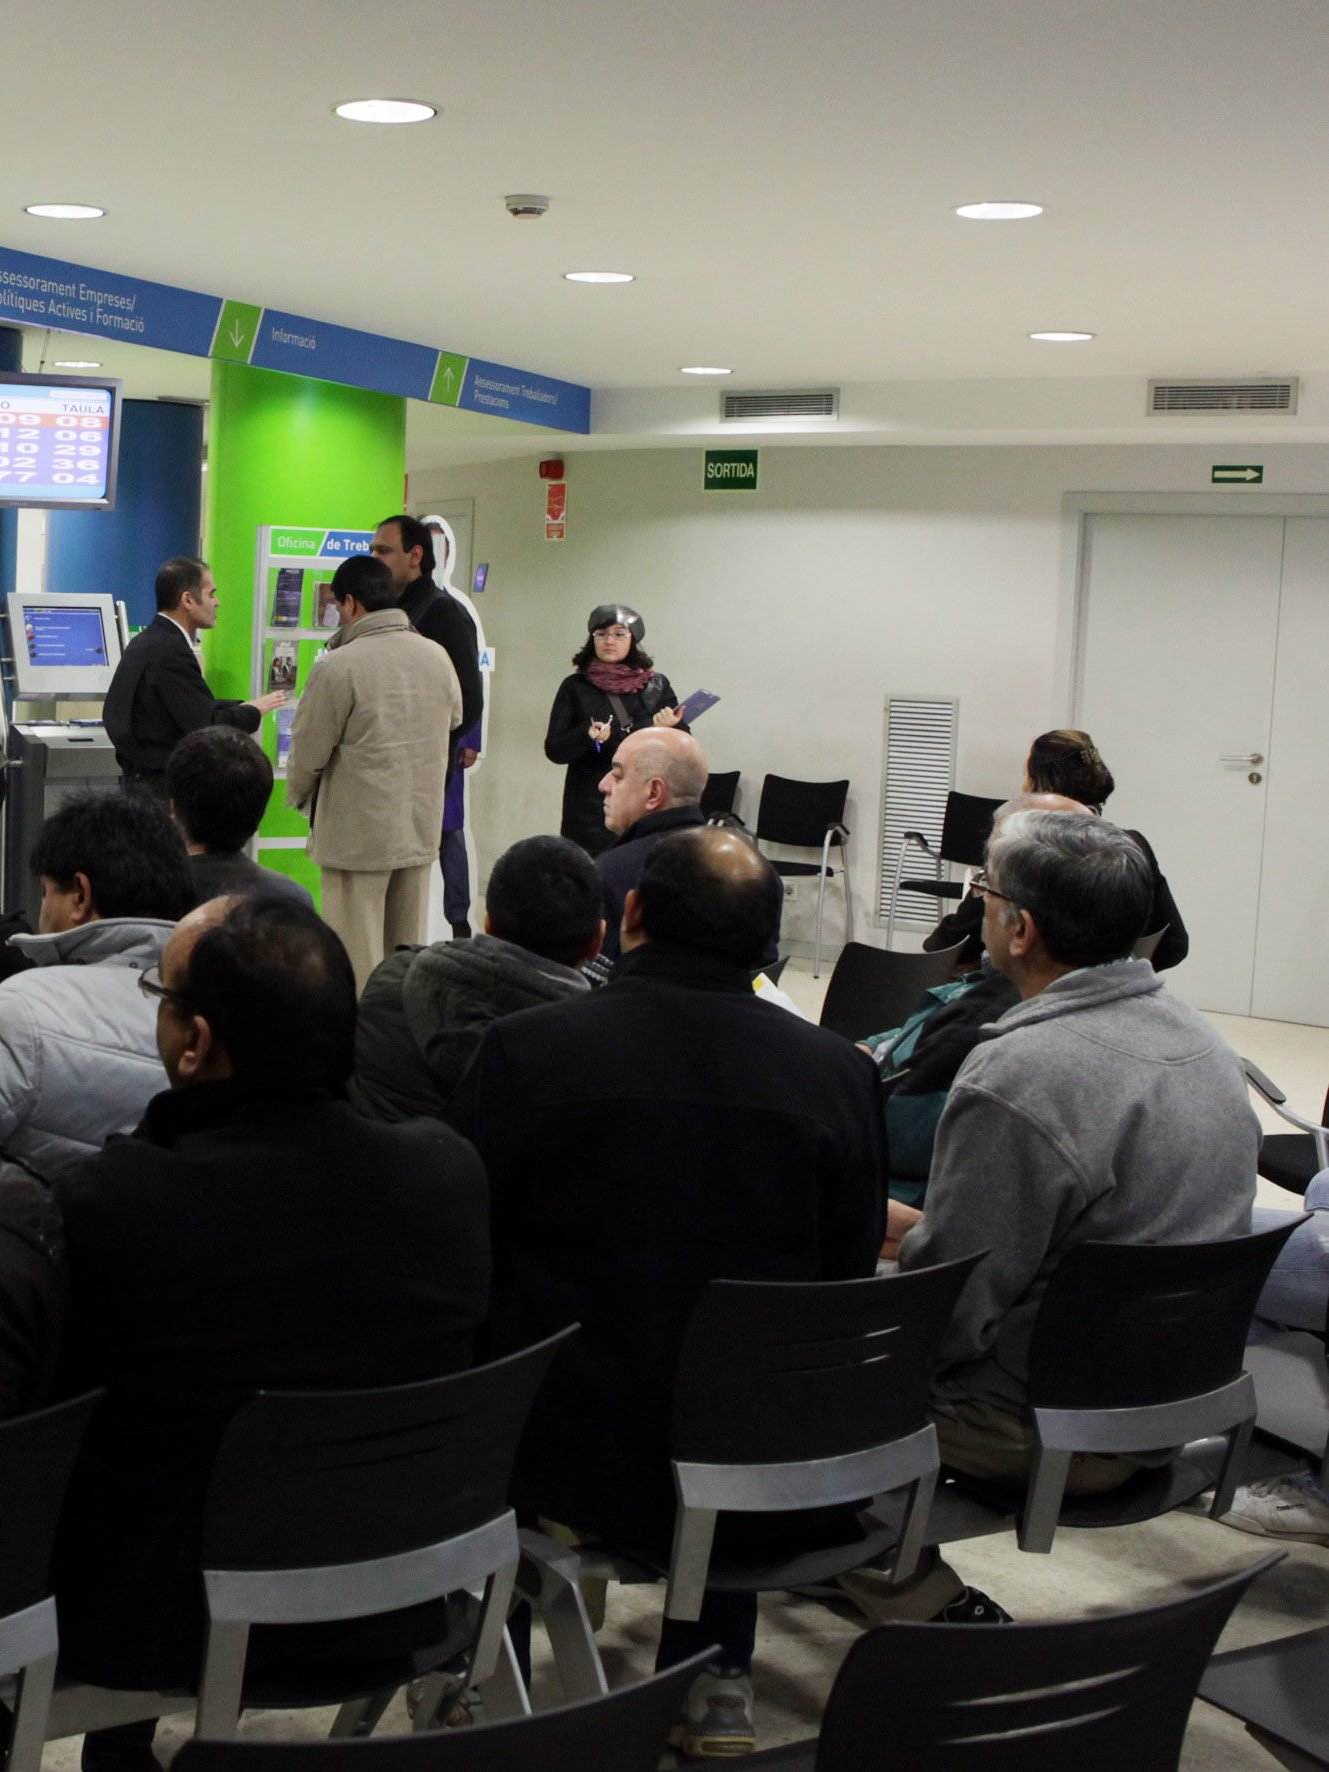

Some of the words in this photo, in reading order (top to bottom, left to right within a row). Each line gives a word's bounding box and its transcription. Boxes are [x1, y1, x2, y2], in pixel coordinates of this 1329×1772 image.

[79, 283, 137, 312] Empreses/
[48, 299, 88, 322] Actives
[96, 308, 145, 333] Formació
[271, 327, 317, 350] Informació
[62, 404, 105, 414] TAULA
[55, 417, 102, 428] 08
[55, 429, 102, 443] 06
[53, 444, 102, 457] 29
[52, 459, 101, 471] 36
[707, 462, 755, 478] SORTIDA
[52, 472, 101, 486] 04
[277, 535, 316, 550] Oficina
[326, 538, 341, 551] de
[480, 651, 490, 666] A
